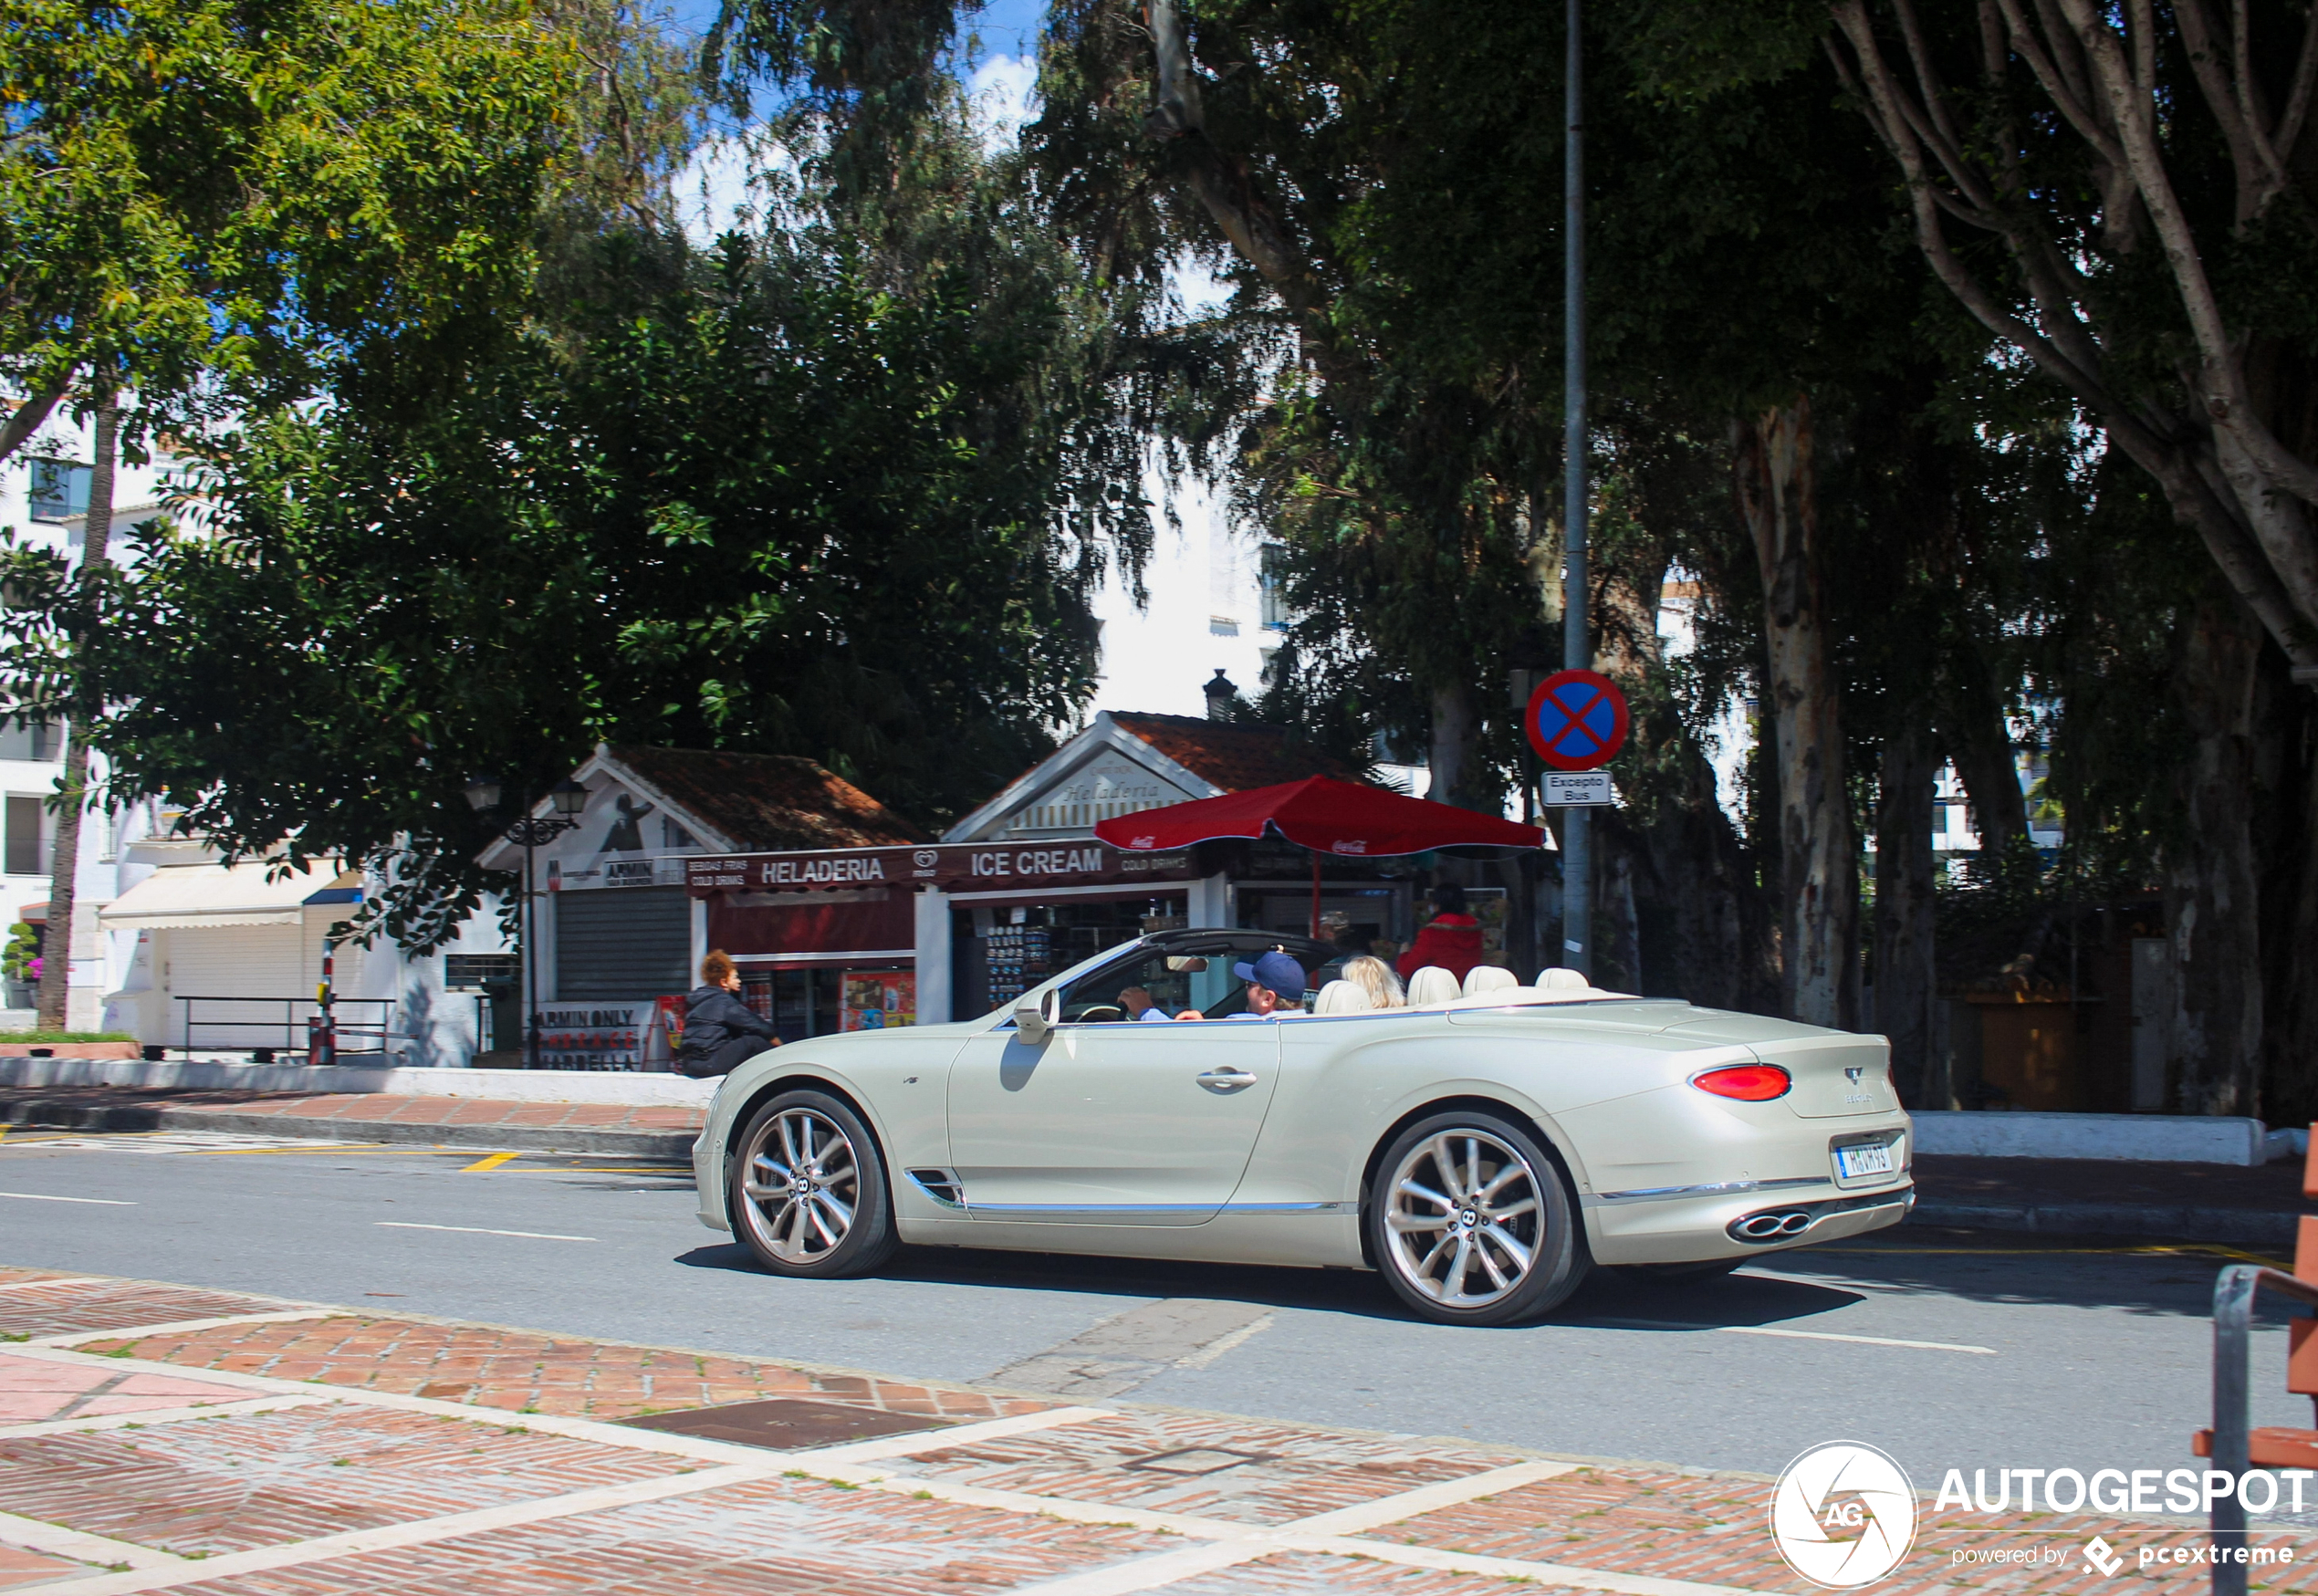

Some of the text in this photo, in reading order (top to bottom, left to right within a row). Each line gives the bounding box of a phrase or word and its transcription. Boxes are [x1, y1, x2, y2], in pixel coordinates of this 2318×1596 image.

[1551, 777, 1603, 788] Excepto
[1565, 790, 1590, 800] Bus
[972, 852, 1010, 876] ICE
[1017, 848, 1102, 875] CREAM
[1121, 857, 1187, 871] COLD DRINKS
[761, 858, 884, 883] HELADERIA
[691, 875, 714, 886] COLD
[715, 875, 745, 886] DRINKS
[591, 1009, 634, 1026] ONLY
